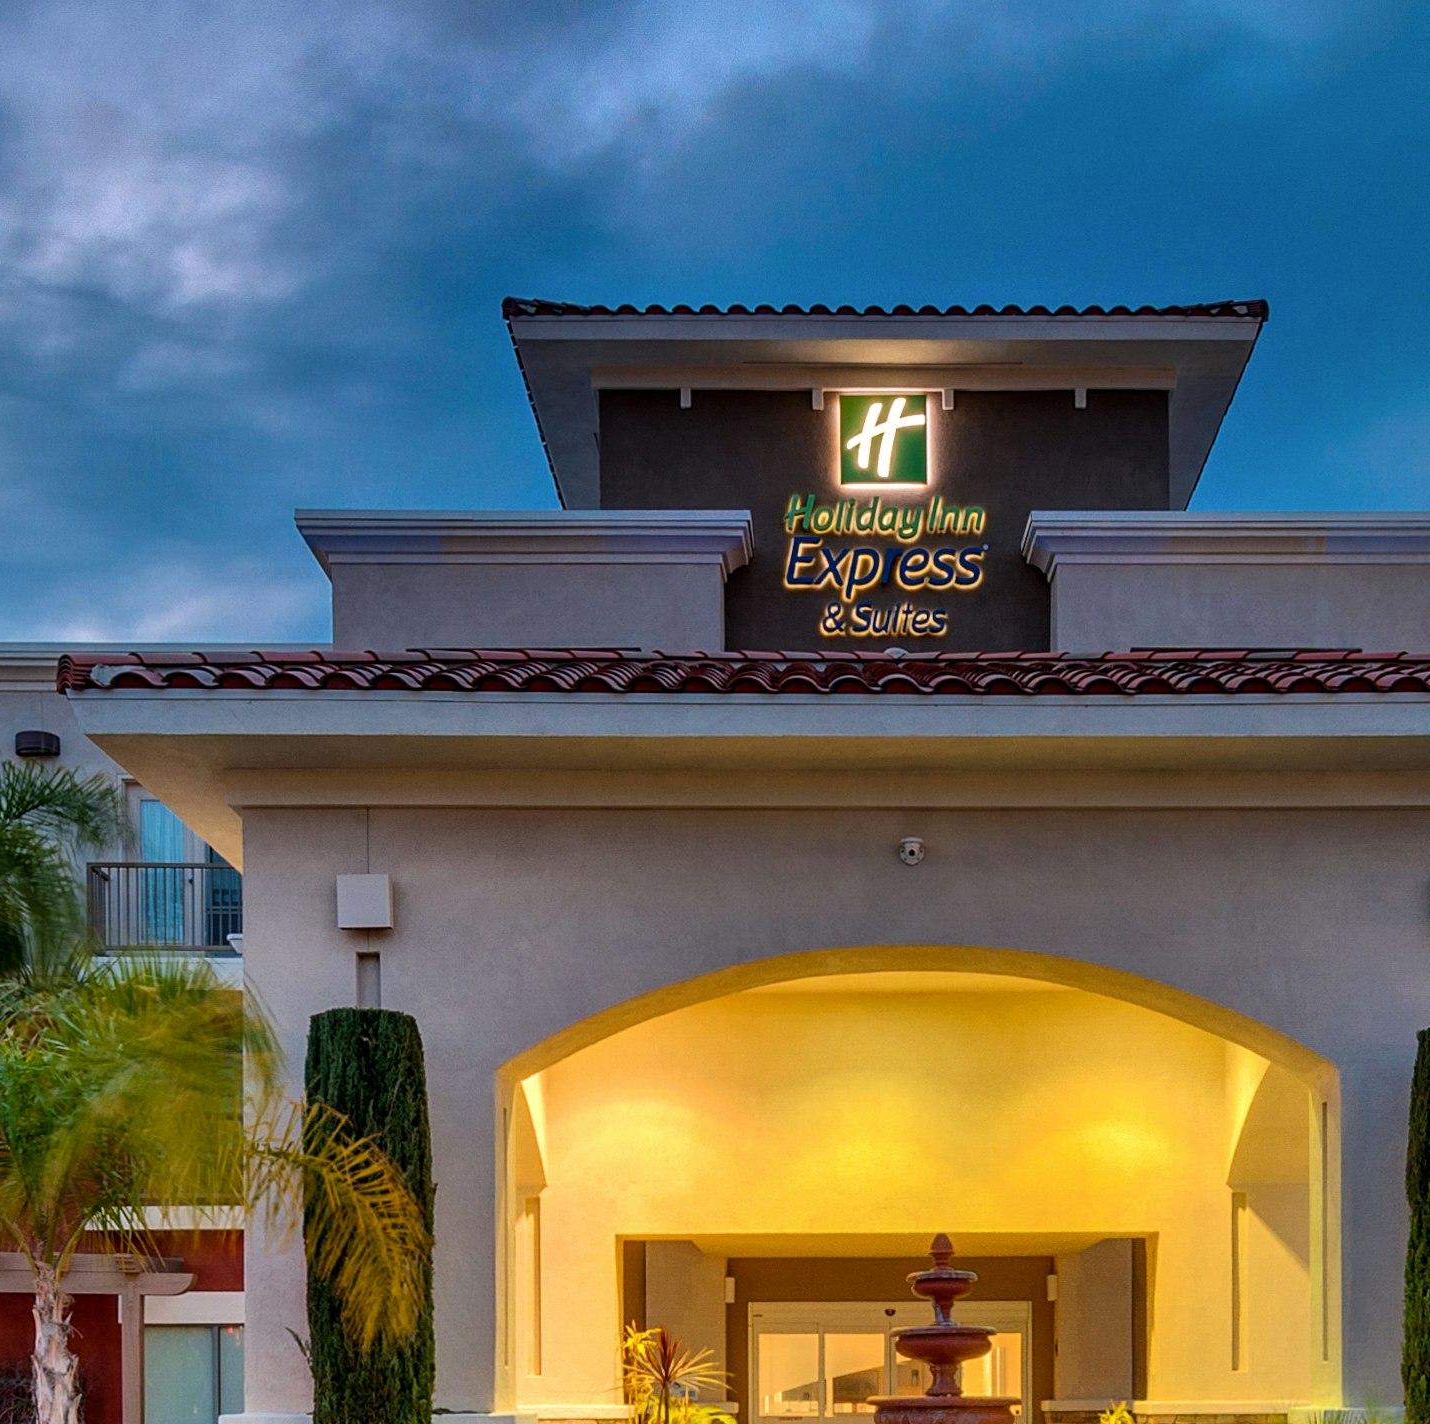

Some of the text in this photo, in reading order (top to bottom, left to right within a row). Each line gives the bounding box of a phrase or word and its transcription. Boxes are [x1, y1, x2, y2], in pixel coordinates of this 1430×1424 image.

[784, 494, 986, 541] Holiday Inn
[784, 536, 985, 600] Express
[821, 600, 948, 636] & Suites
